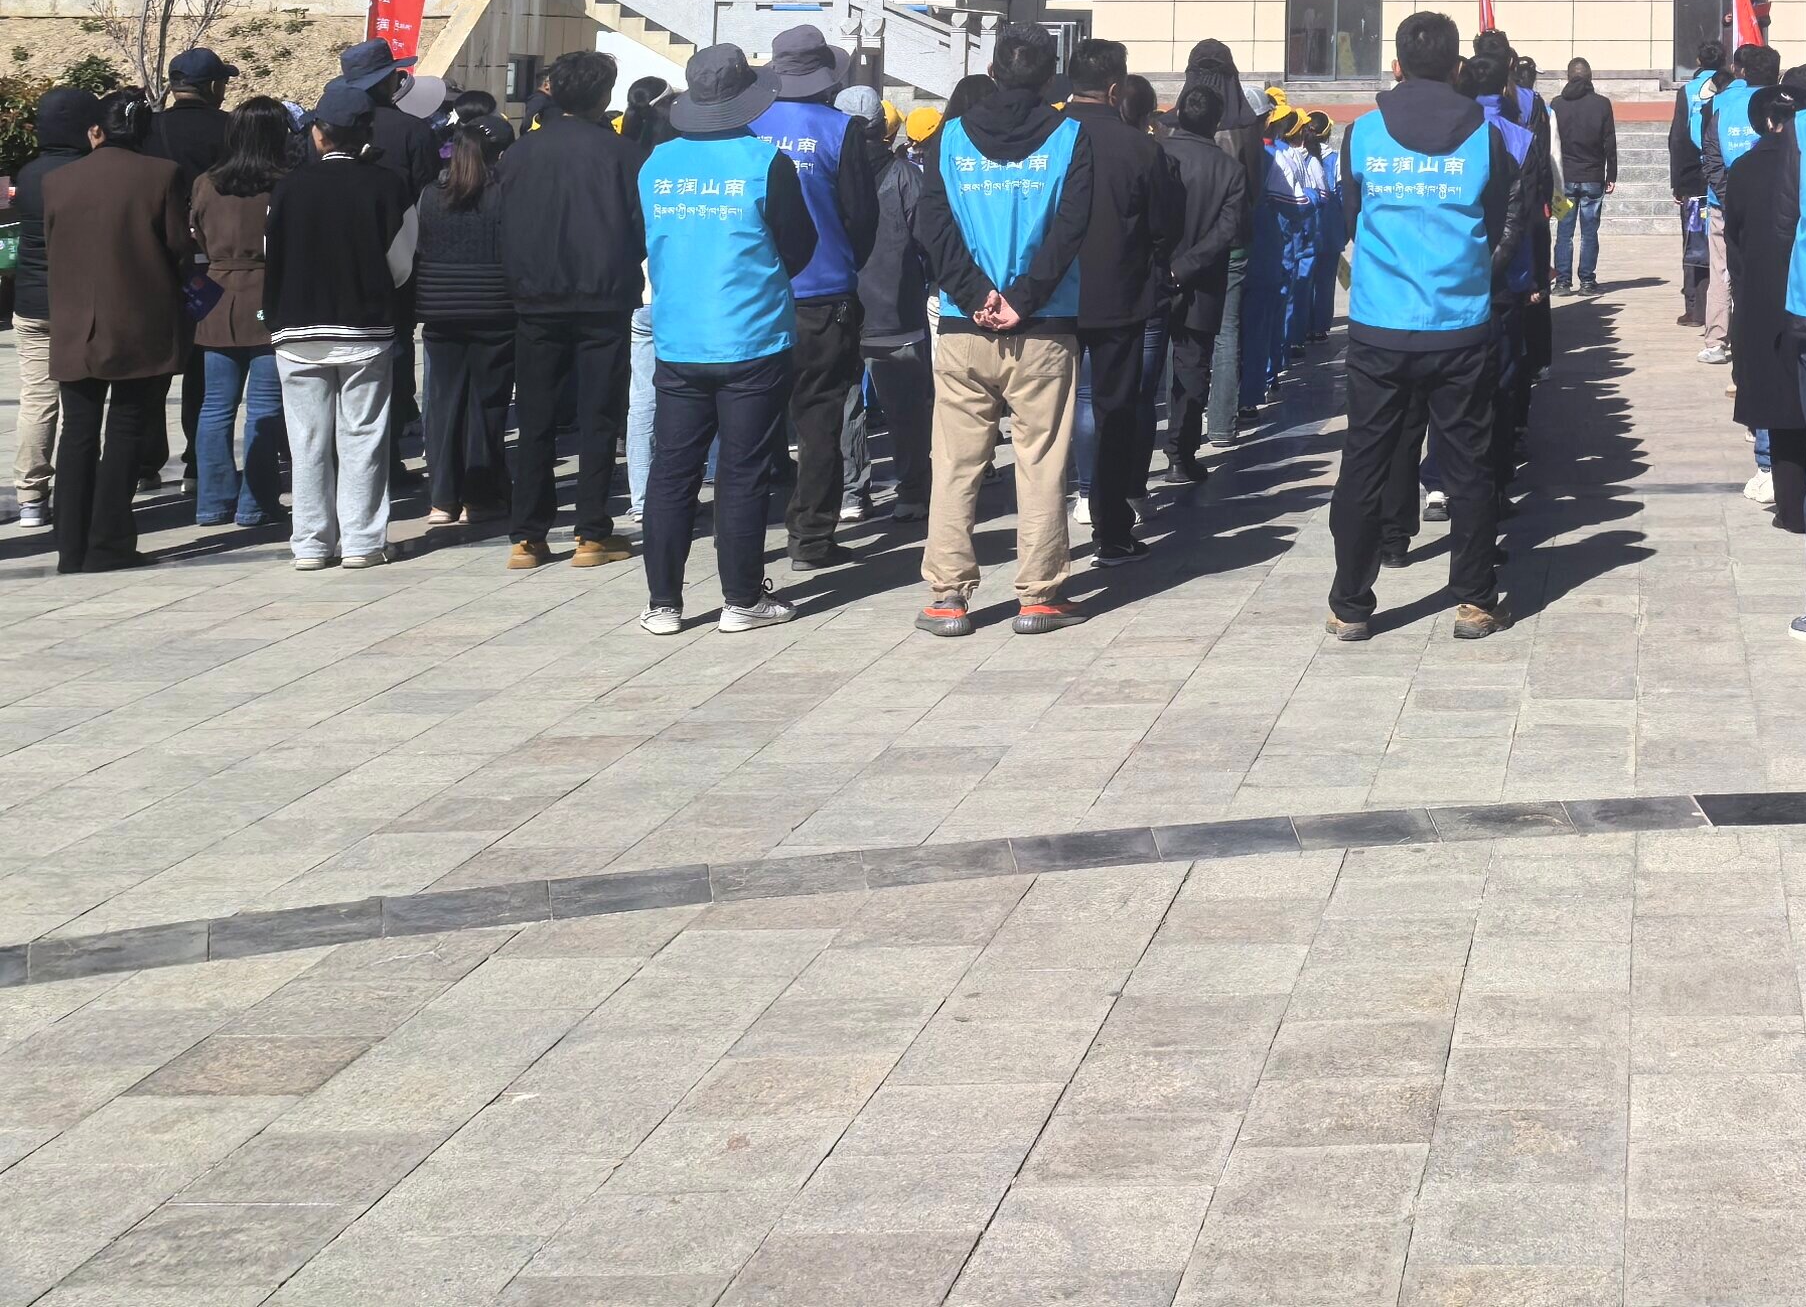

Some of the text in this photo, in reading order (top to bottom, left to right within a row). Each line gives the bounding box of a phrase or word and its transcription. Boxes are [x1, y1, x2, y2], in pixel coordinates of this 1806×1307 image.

[1366, 156, 1466, 175] 法润山南
[654, 178, 746, 196] 法润山南
